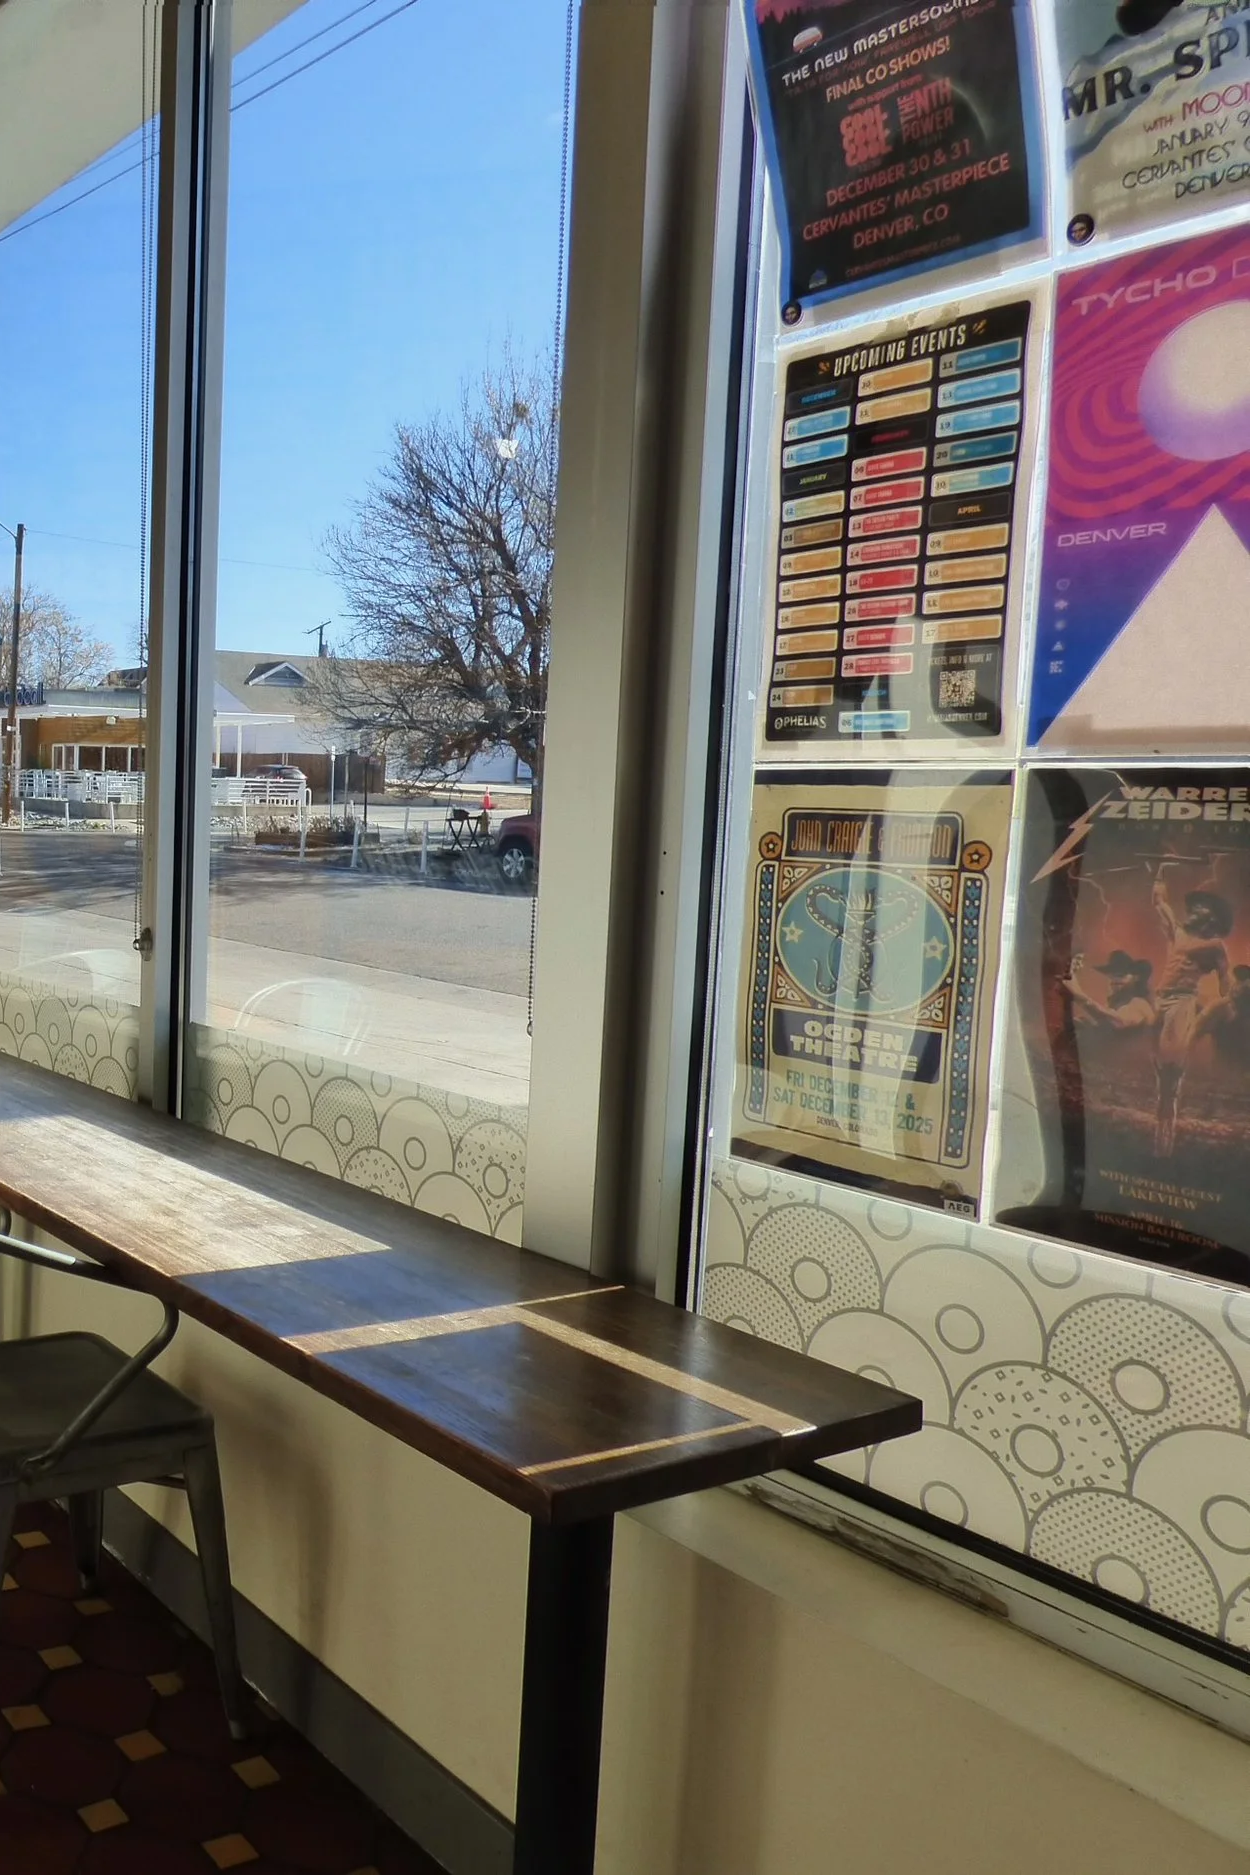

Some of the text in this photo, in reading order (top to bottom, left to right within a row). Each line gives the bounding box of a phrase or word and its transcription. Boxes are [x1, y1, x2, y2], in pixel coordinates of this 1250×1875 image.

[781, 65, 810, 87] THE
[815, 46, 848, 72] NEW
[826, 76, 864, 101] FINAL
[865, 66, 888, 84] CO
[890, 35, 950, 74] SHOWS!
[1173, 19, 1250, 81] SP
[1062, 66, 1150, 121] MR.
[1143, 82, 1250, 133] WITH MOO
[902, 107, 954, 145] POWER
[1152, 116, 1228, 156] JANUARY
[826, 163, 905, 207] DECEMBER
[910, 155, 929, 175] 30
[934, 148, 947, 165] &
[951, 139, 971, 160] 31
[803, 153, 1010, 240] CERVANTES' MASTERPIECE
[853, 204, 948, 248] DENVER, CO
[1071, 265, 1217, 316] TYCHO
[833, 324, 967, 378] UPCOMING EVENTS
[957, 505, 982, 515] APRIL
[1056, 521, 1168, 549] DENVER
[791, 819, 822, 852] JOHN
[790, 1035, 918, 1073] THEATRE
[804, 1020, 904, 1052] OGDEN
[786, 1069, 804, 1088] FRI
[810, 1074, 878, 1104] DECEMBER
[905, 1093, 915, 1111] &
[773, 1087, 795, 1106] SAT
[800, 1092, 867, 1121] DECEMBER
[896, 1113, 933, 1135] 2025
[1099, 1169, 1222, 1204] WITH SPECIAL GUEST
[1119, 1184, 1198, 1211] LAKEVIEW
[1094, 1212, 1144, 1232] MISSION
[1148, 1222, 1221, 1250] BALLROOM
[1130, 1210, 1164, 1226] APRIL
